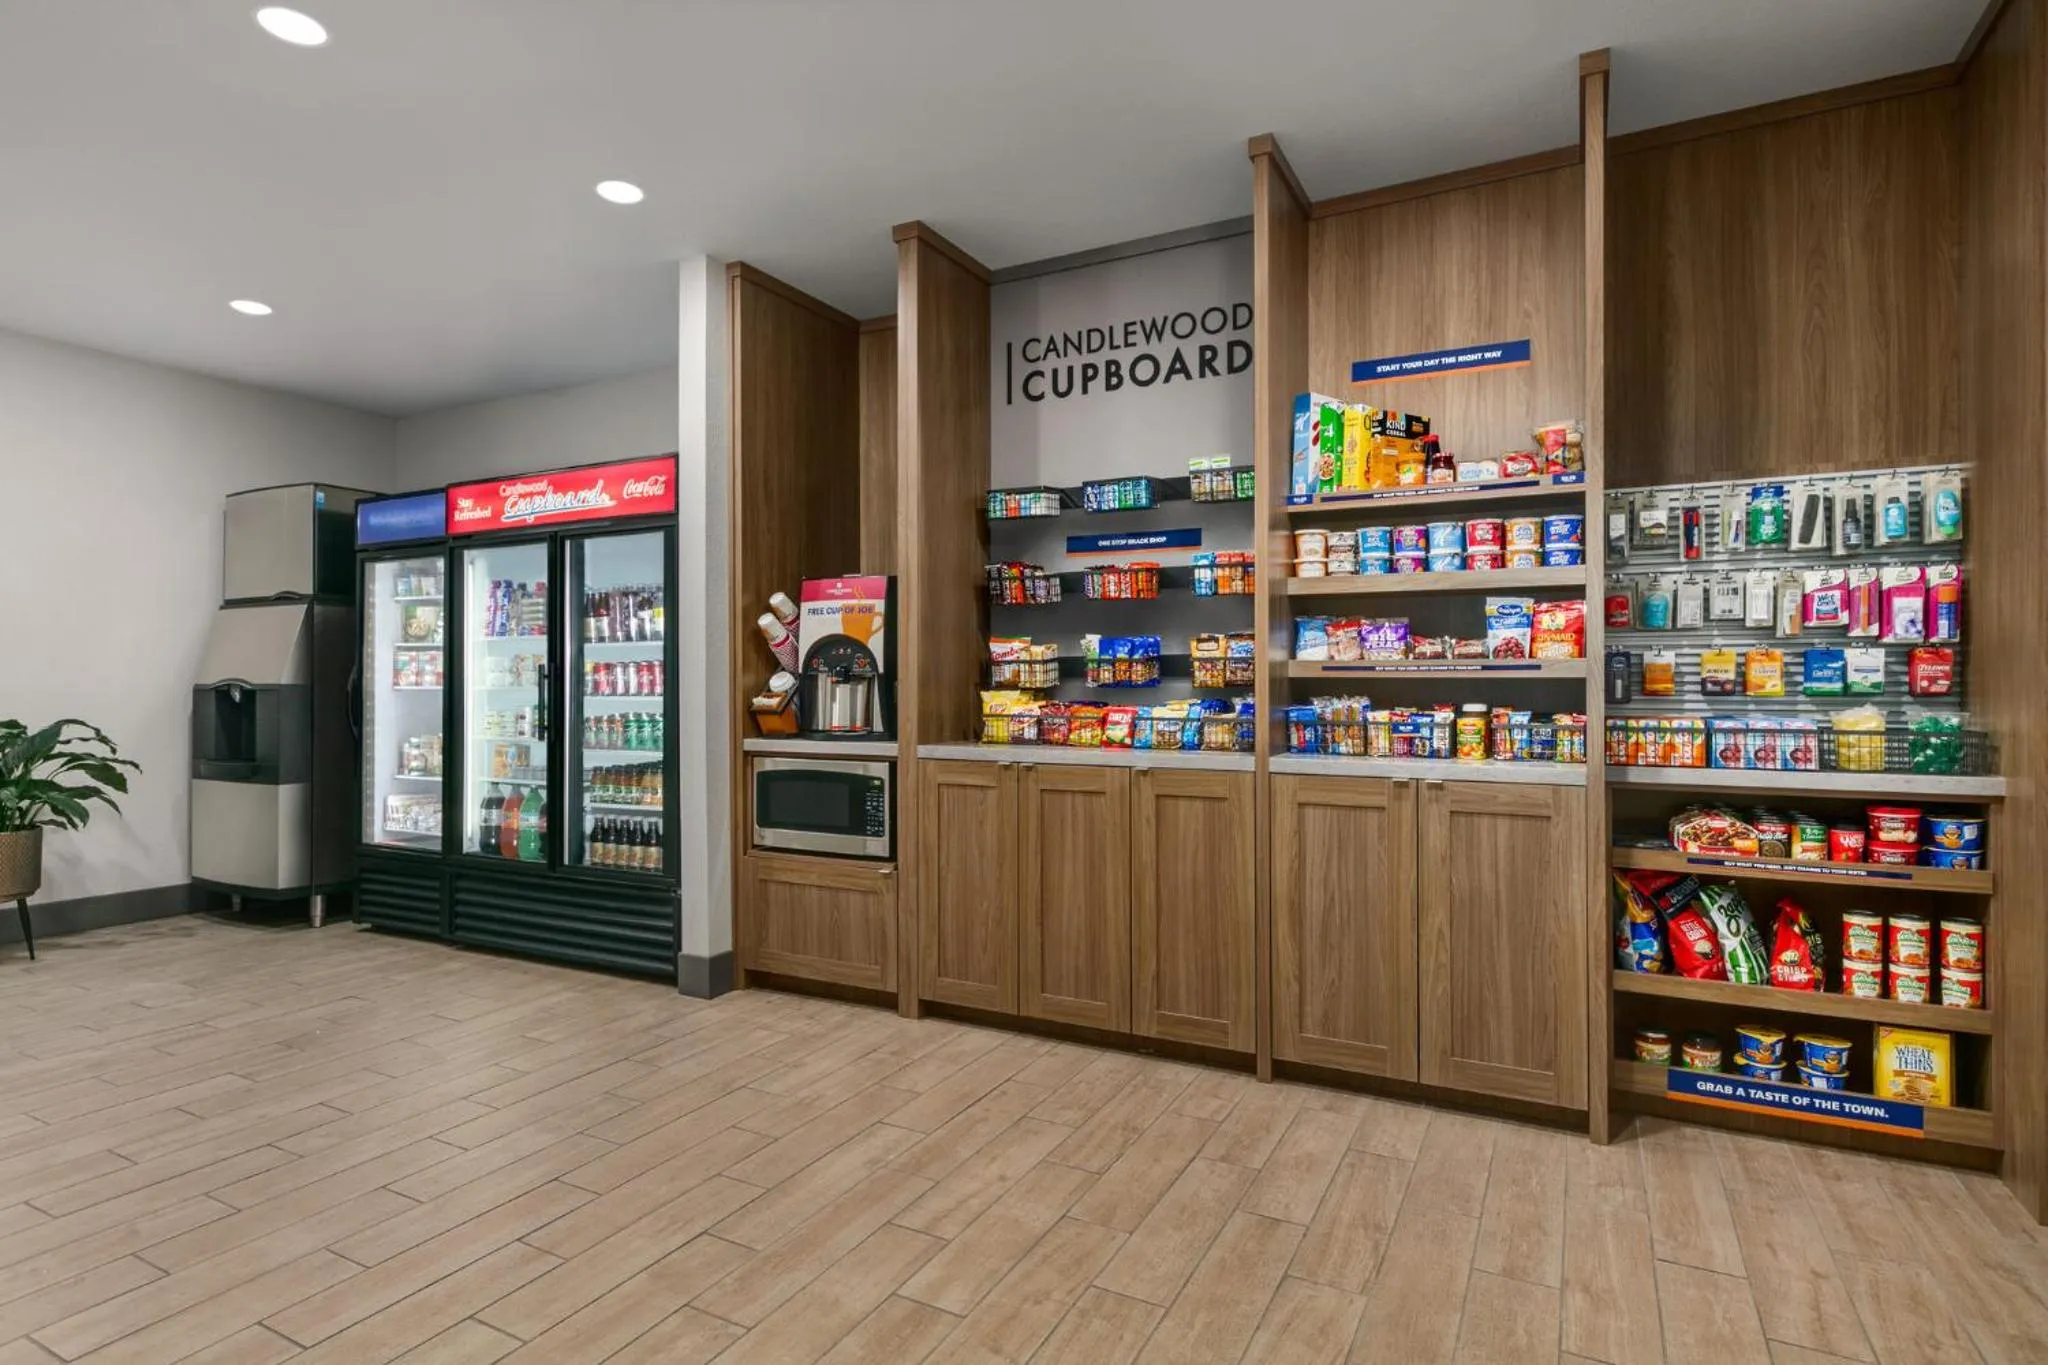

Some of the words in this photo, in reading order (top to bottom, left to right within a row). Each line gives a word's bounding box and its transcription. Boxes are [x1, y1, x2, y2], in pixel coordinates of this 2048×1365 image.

[1021, 302, 1254, 363] CANDLEWOOD
[1376, 364, 1401, 373] START
[1402, 361, 1423, 370] YOUR
[1424, 358, 1439, 367] DAY
[1440, 356, 1456, 365] THE
[1458, 353, 1483, 363] RIGHT
[1483, 350, 1502, 359] WAY
[1021, 339, 1254, 402] CUPBOARD
[1386, 420, 1406, 430] KIND
[499, 480, 549, 497] Candlewood
[457, 497, 475, 509] Stay
[503, 480, 604, 522] Cupboard
[454, 506, 492, 521] Refreshed
[1149, 536, 1167, 544] SHOP
[807, 606, 825, 616] FREE
[826, 606, 844, 615] CUP
[845, 605, 855, 614] OF
[1894, 1045, 1934, 1060] WHEAT
[1895, 1055, 1934, 1073] THINS
[1696, 1081, 1733, 1095] GRAB
[1735, 1087, 1746, 1097] A
[1748, 1089, 1789, 1104] TASTE
[1792, 1096, 1811, 1106] OF
[1812, 1098, 1842, 1112] THE
[1844, 1103, 1889, 1118] TOWN.
